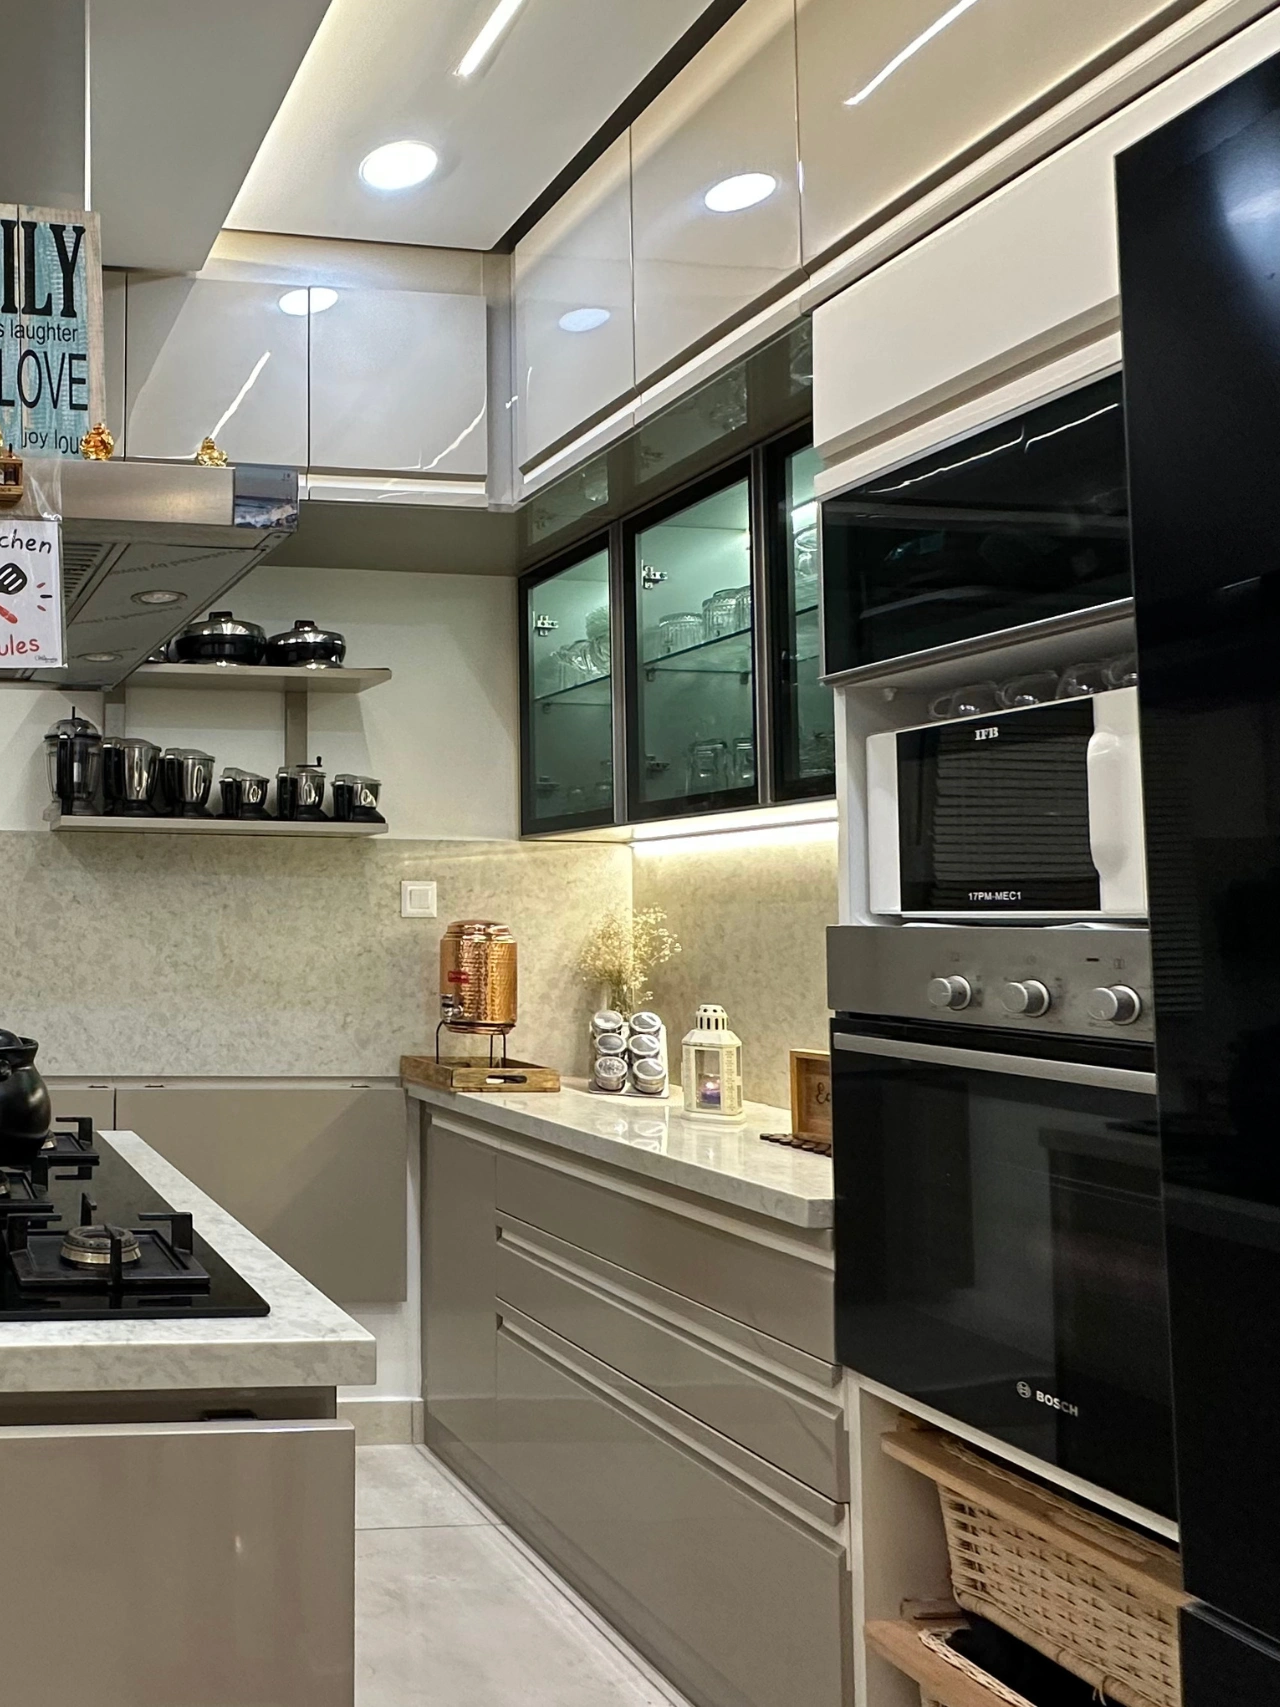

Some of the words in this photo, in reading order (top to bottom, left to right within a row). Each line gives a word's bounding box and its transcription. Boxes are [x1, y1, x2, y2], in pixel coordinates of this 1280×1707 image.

[10, 319, 78, 345] laughter
[22, 428, 48, 449] joy
[54, 429, 89, 455] lou
[974, 726, 999, 741] IFB
[968, 891, 1022, 901] 17PM-MEC1
[1035, 1390, 1079, 1417] BOSCH
